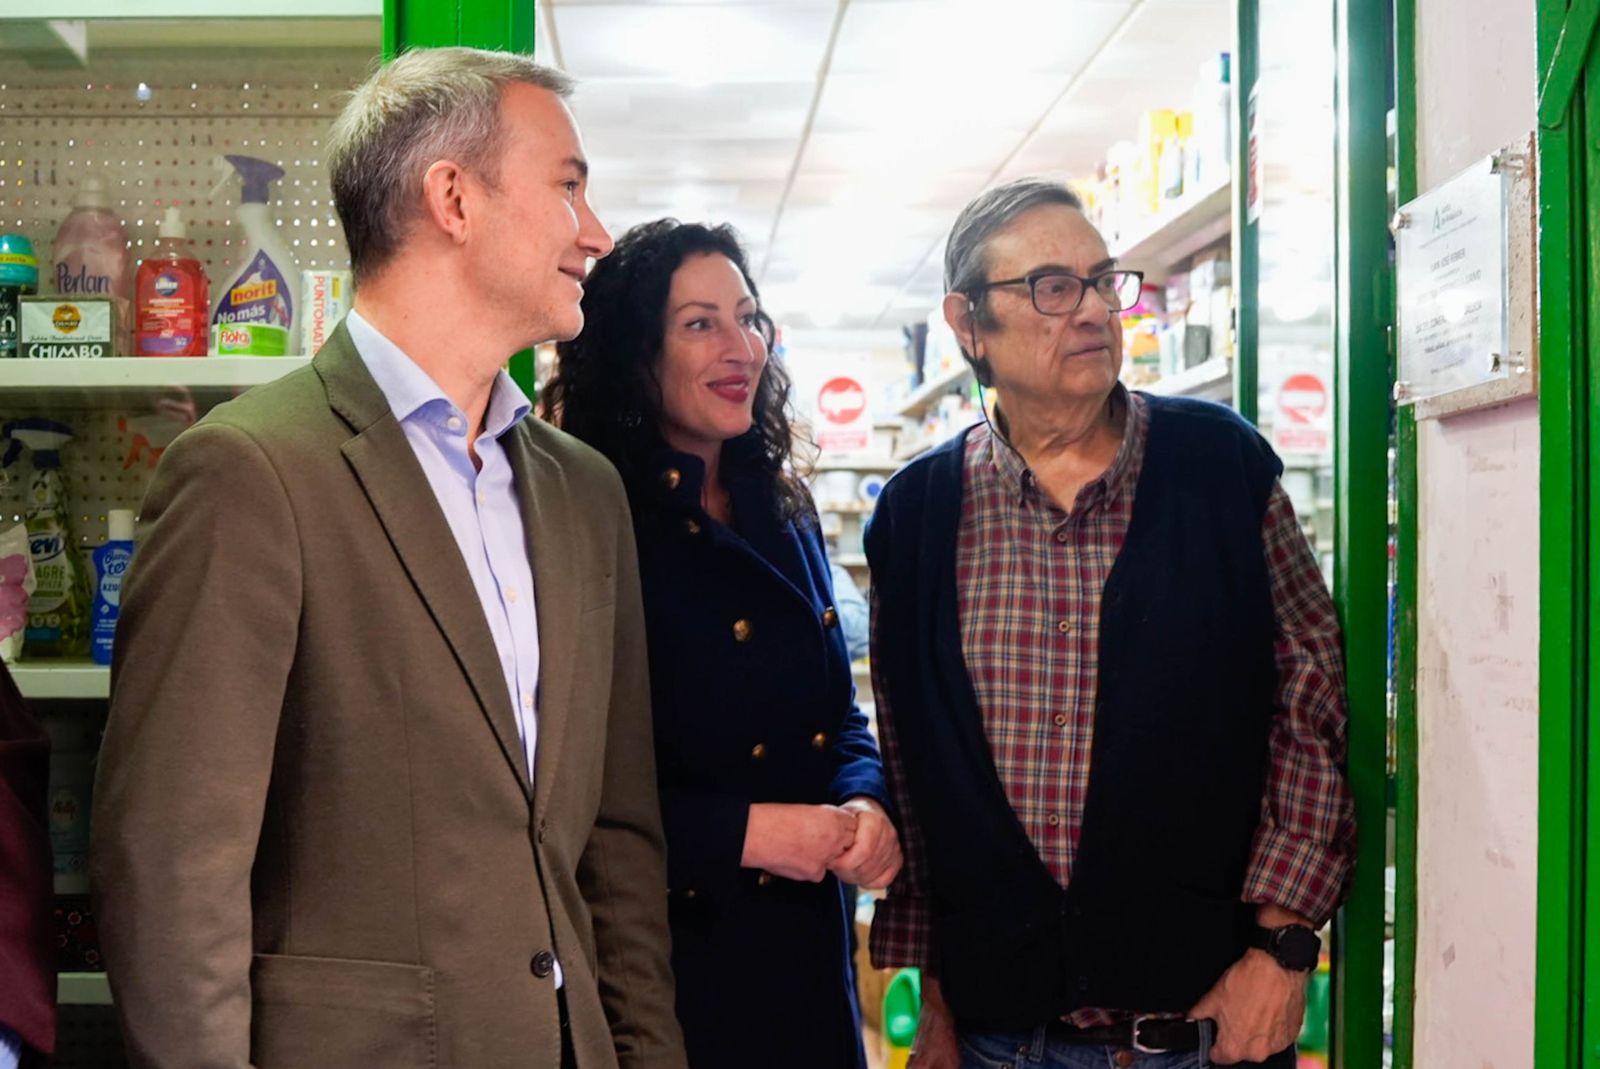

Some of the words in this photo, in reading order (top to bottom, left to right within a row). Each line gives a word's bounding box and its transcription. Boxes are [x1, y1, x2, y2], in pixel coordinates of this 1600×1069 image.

[56, 261, 110, 293] Perlan
[233, 283, 274, 302] norit
[217, 312, 236, 324] No
[237, 304, 265, 321] más
[28, 343, 103, 358] CHIMBO
[31, 534, 60, 554] evi
[35, 565, 65, 579] AGRE
